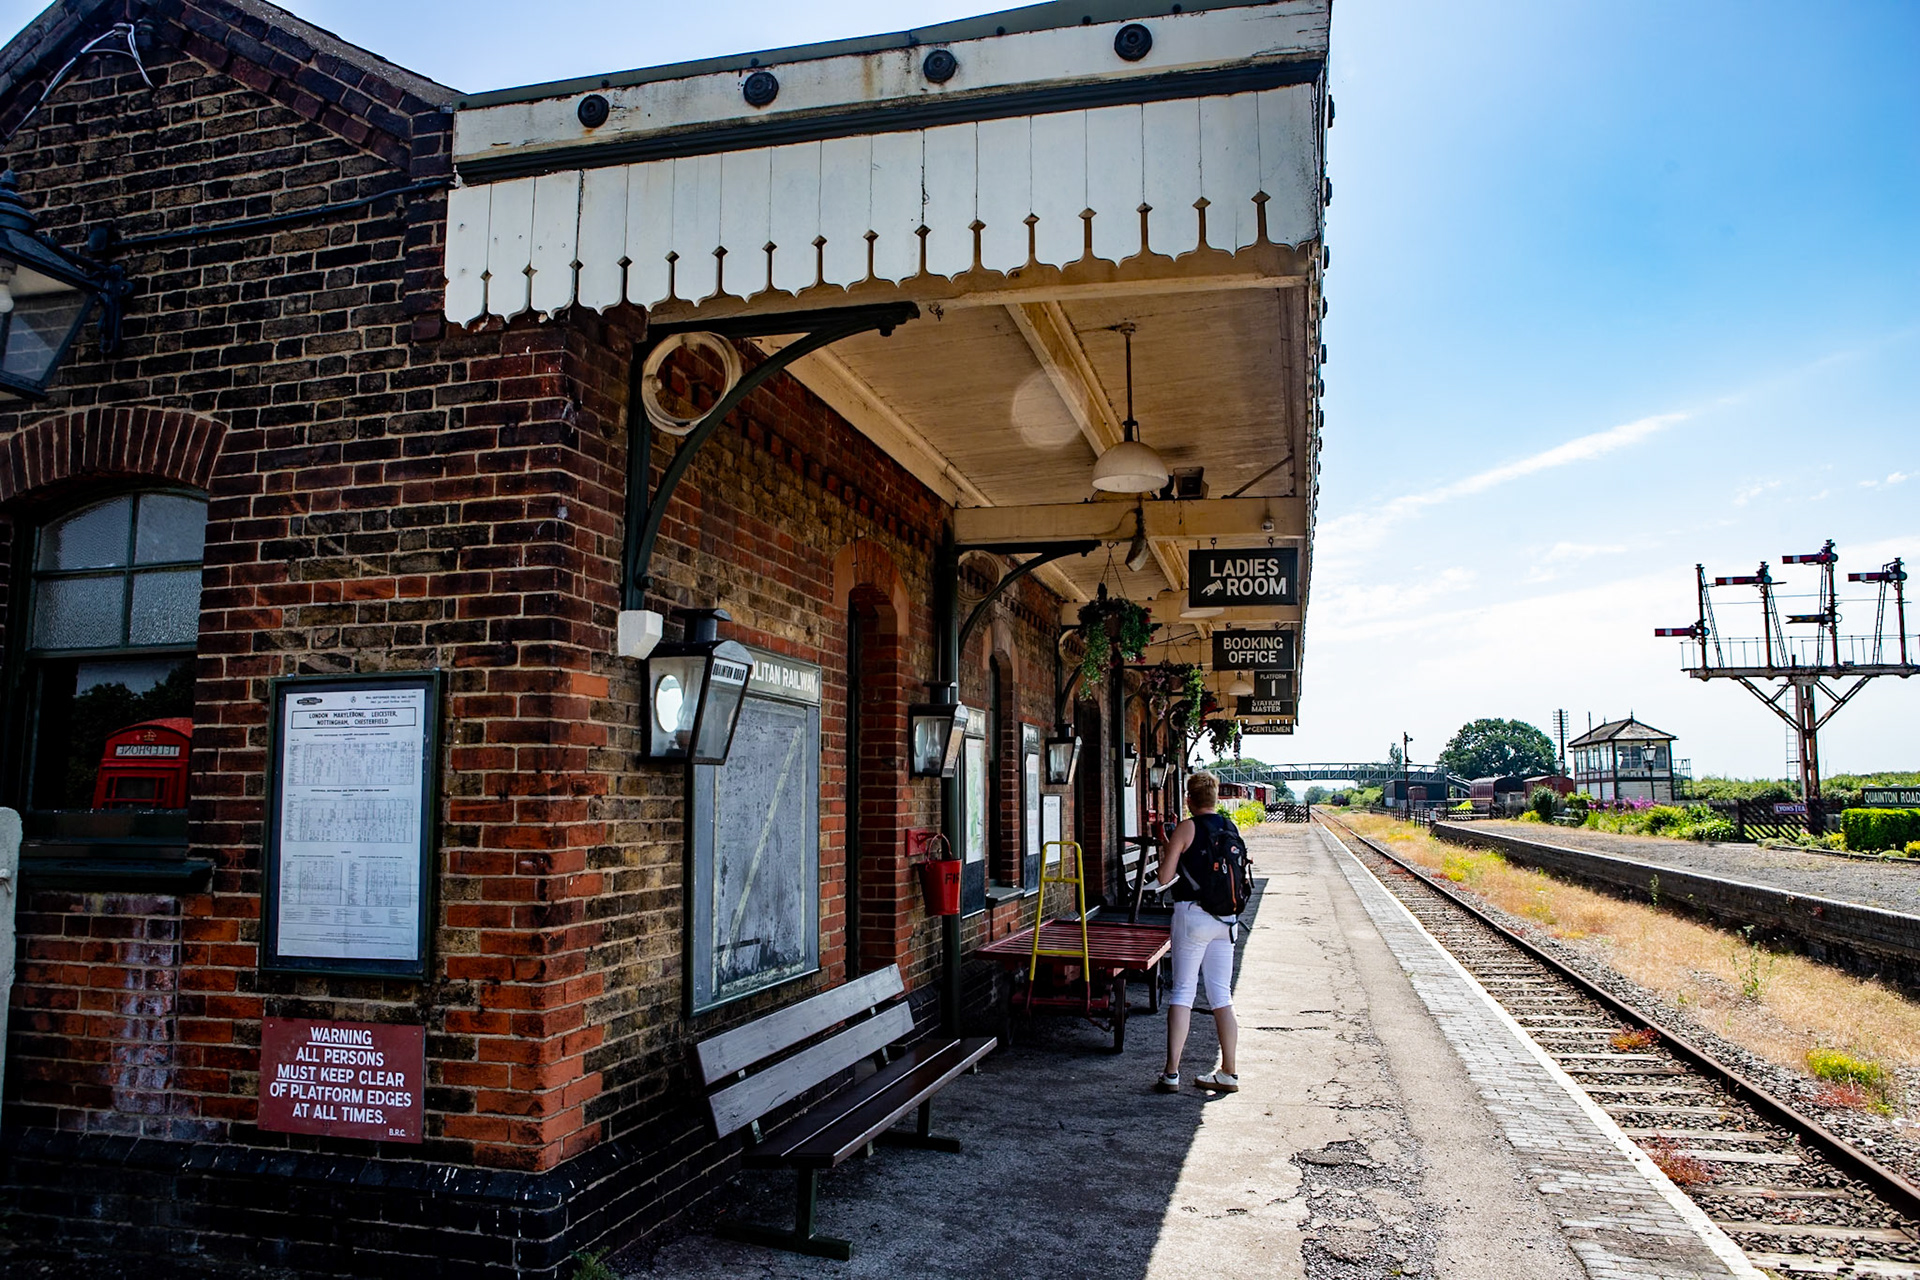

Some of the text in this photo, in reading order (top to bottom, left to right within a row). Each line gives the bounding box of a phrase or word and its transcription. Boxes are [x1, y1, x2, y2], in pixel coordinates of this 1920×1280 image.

[1210, 558, 1279, 577] LADIES
[1226, 577, 1287, 596] ROOM
[1223, 636, 1284, 650] BOOKING
[1228, 651, 1277, 664] OFFICE
[782, 667, 816, 692] RAILWAY
[1271, 680, 1276, 696] 1
[1251, 725, 1291, 733] GENTLEMEN
[1864, 791, 1920, 804] QUAINTON ROAD
[310, 1026, 372, 1045] WARNING
[295, 1046, 384, 1067] ALL PERSONS
[277, 1064, 405, 1087] MUST KEEP CLEAR
[269, 1082, 412, 1107] OF PLATFORM EDGES
[292, 1103, 387, 1124] AT ALL TIMES.
